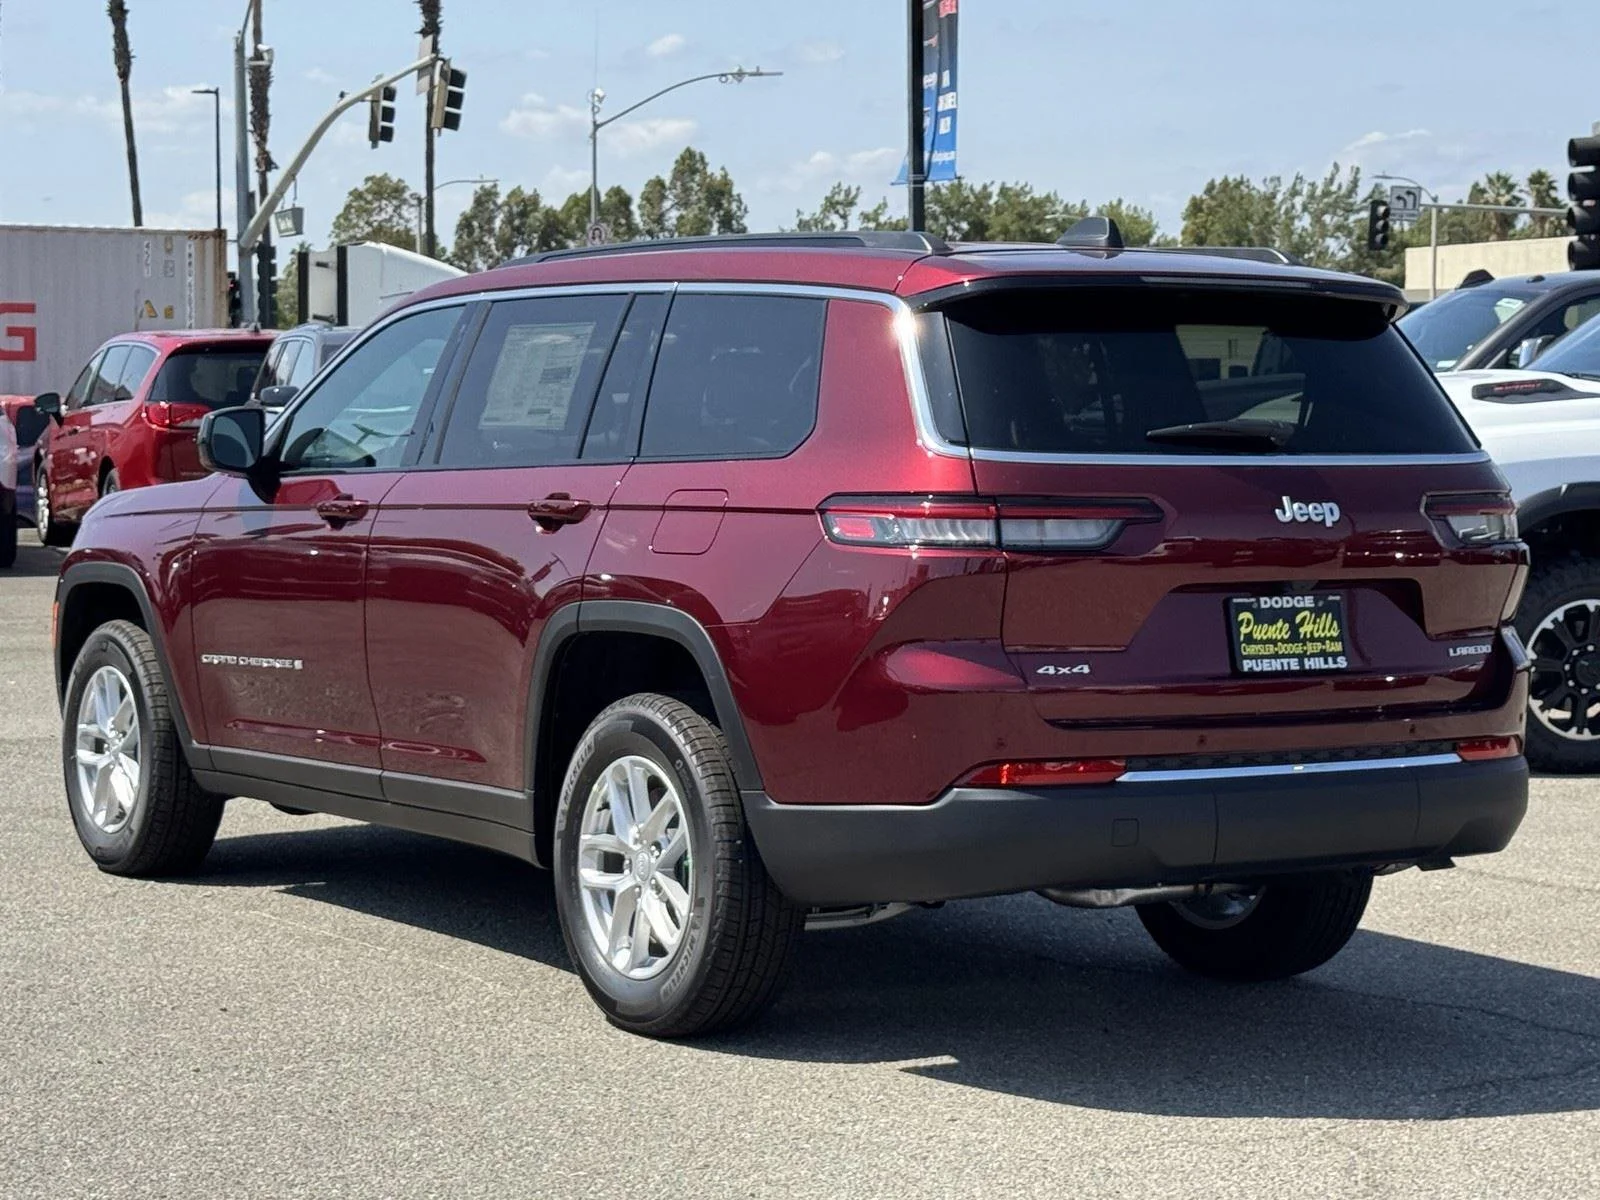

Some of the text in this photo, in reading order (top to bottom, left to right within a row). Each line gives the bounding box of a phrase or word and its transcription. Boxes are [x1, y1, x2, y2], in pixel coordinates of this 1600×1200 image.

[1275, 496, 1340, 527] Jeep
[1260, 596, 1315, 608] DODGE
[1237, 610, 1340, 640] Puente Hills
[1449, 645, 1492, 657] LAREDO
[1243, 656, 1348, 671] PUENTE HILLS
[564, 742, 593, 805] MICHELIN
